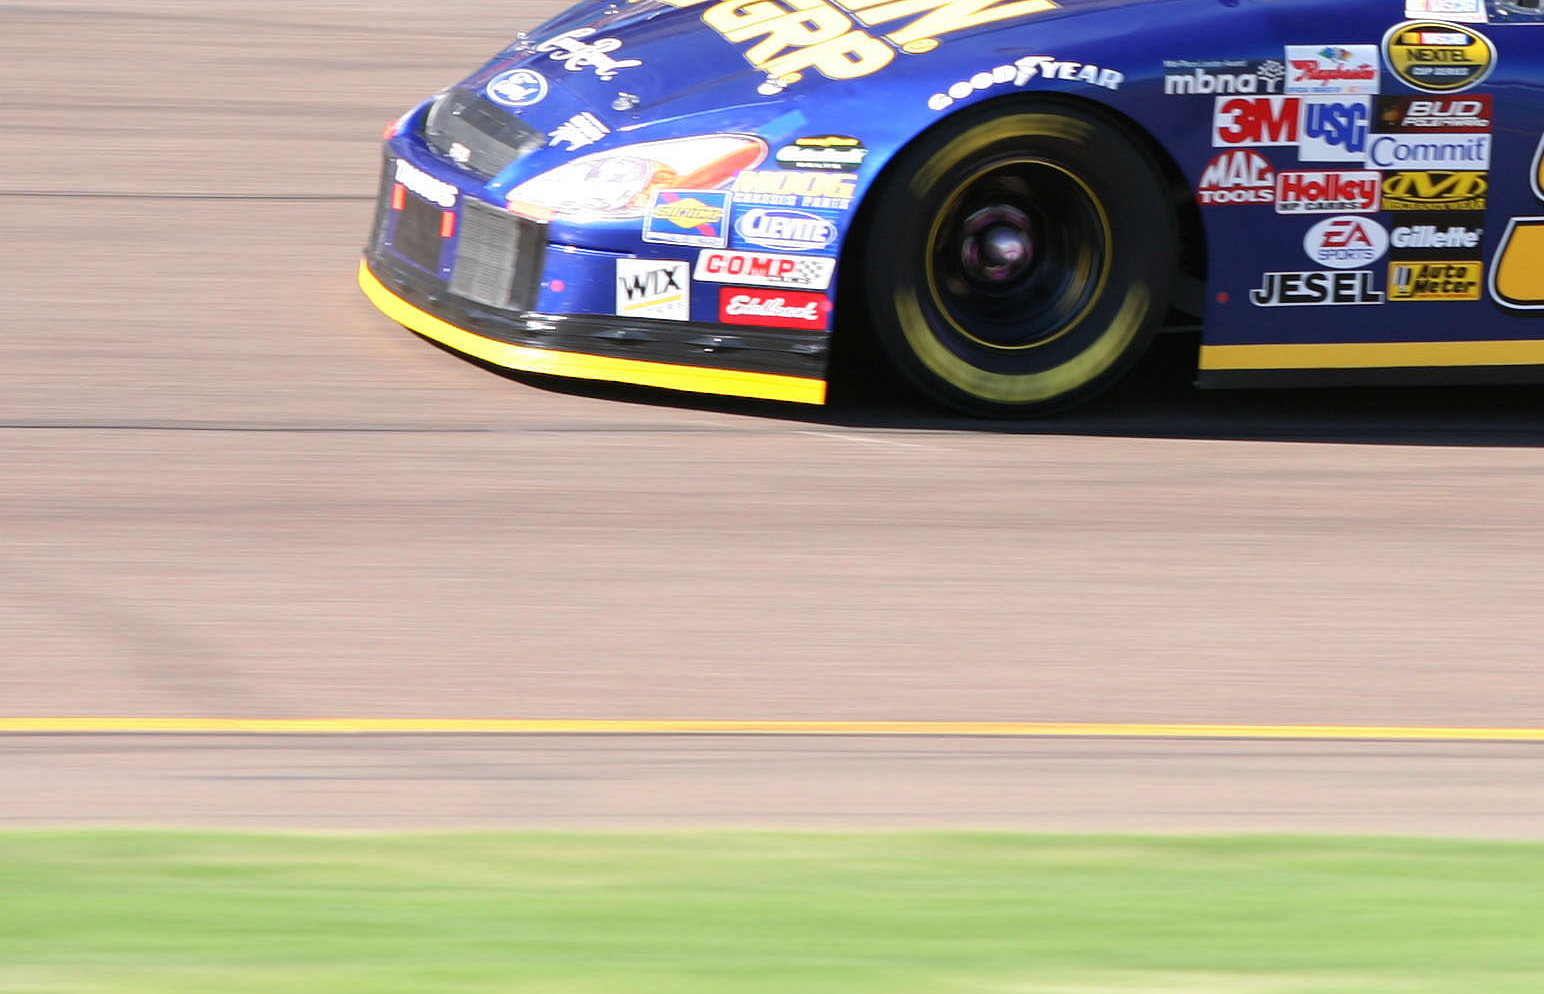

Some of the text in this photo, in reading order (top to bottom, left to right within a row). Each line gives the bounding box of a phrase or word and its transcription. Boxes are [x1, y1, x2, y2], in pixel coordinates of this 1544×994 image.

[1407, 48, 1473, 62] NEXTEL
[927, 56, 1125, 110] GOODYEAR
[1164, 69, 1259, 95] mbna
[1218, 98, 1301, 144] 3M
[1406, 100, 1483, 117] BUD
[1305, 102, 1368, 153] USG
[1371, 136, 1487, 167] Commit
[1200, 150, 1276, 189] MAC
[731, 170, 858, 199] MOOG
[1199, 189, 1275, 203] TOOLS
[1280, 173, 1377, 209] Holley
[1320, 220, 1373, 248] EA
[1389, 224, 1481, 248] Gillette
[706, 254, 797, 277] COMP
[1318, 248, 1375, 261] SPORTS
[618, 265, 683, 301] WIX
[1417, 265, 1468, 279] Auto
[1254, 273, 1381, 305] JESEL
